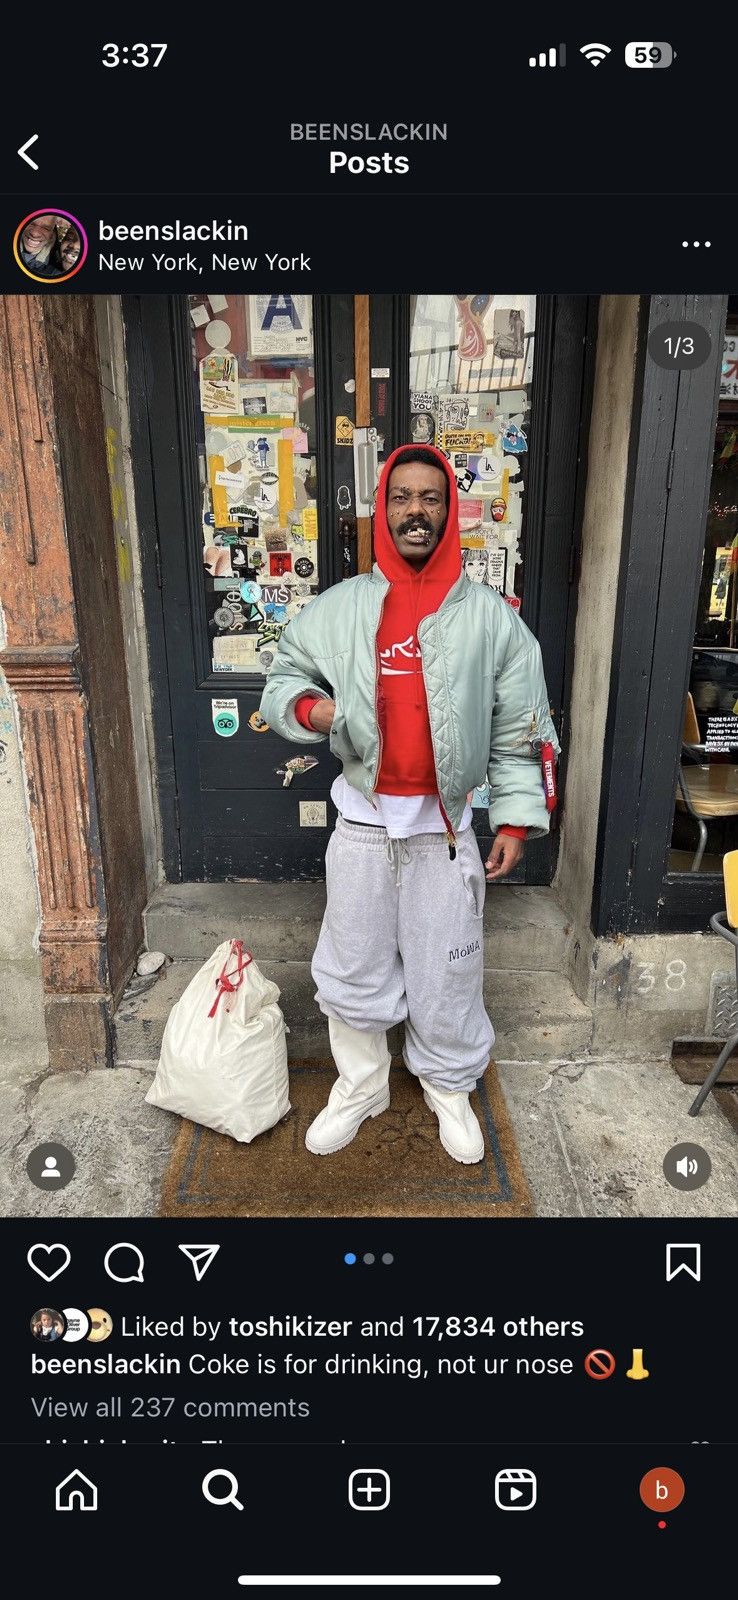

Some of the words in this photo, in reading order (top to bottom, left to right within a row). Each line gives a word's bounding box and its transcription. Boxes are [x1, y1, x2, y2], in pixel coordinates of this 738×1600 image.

[260, 295, 303, 330] A
[229, 506, 257, 517] CEREBRO
[264, 588, 289, 603] MS
[544, 760, 555, 797] VETEMENTS
[448, 940, 481, 962] MoWA
[637, 958, 687, 994] 38
